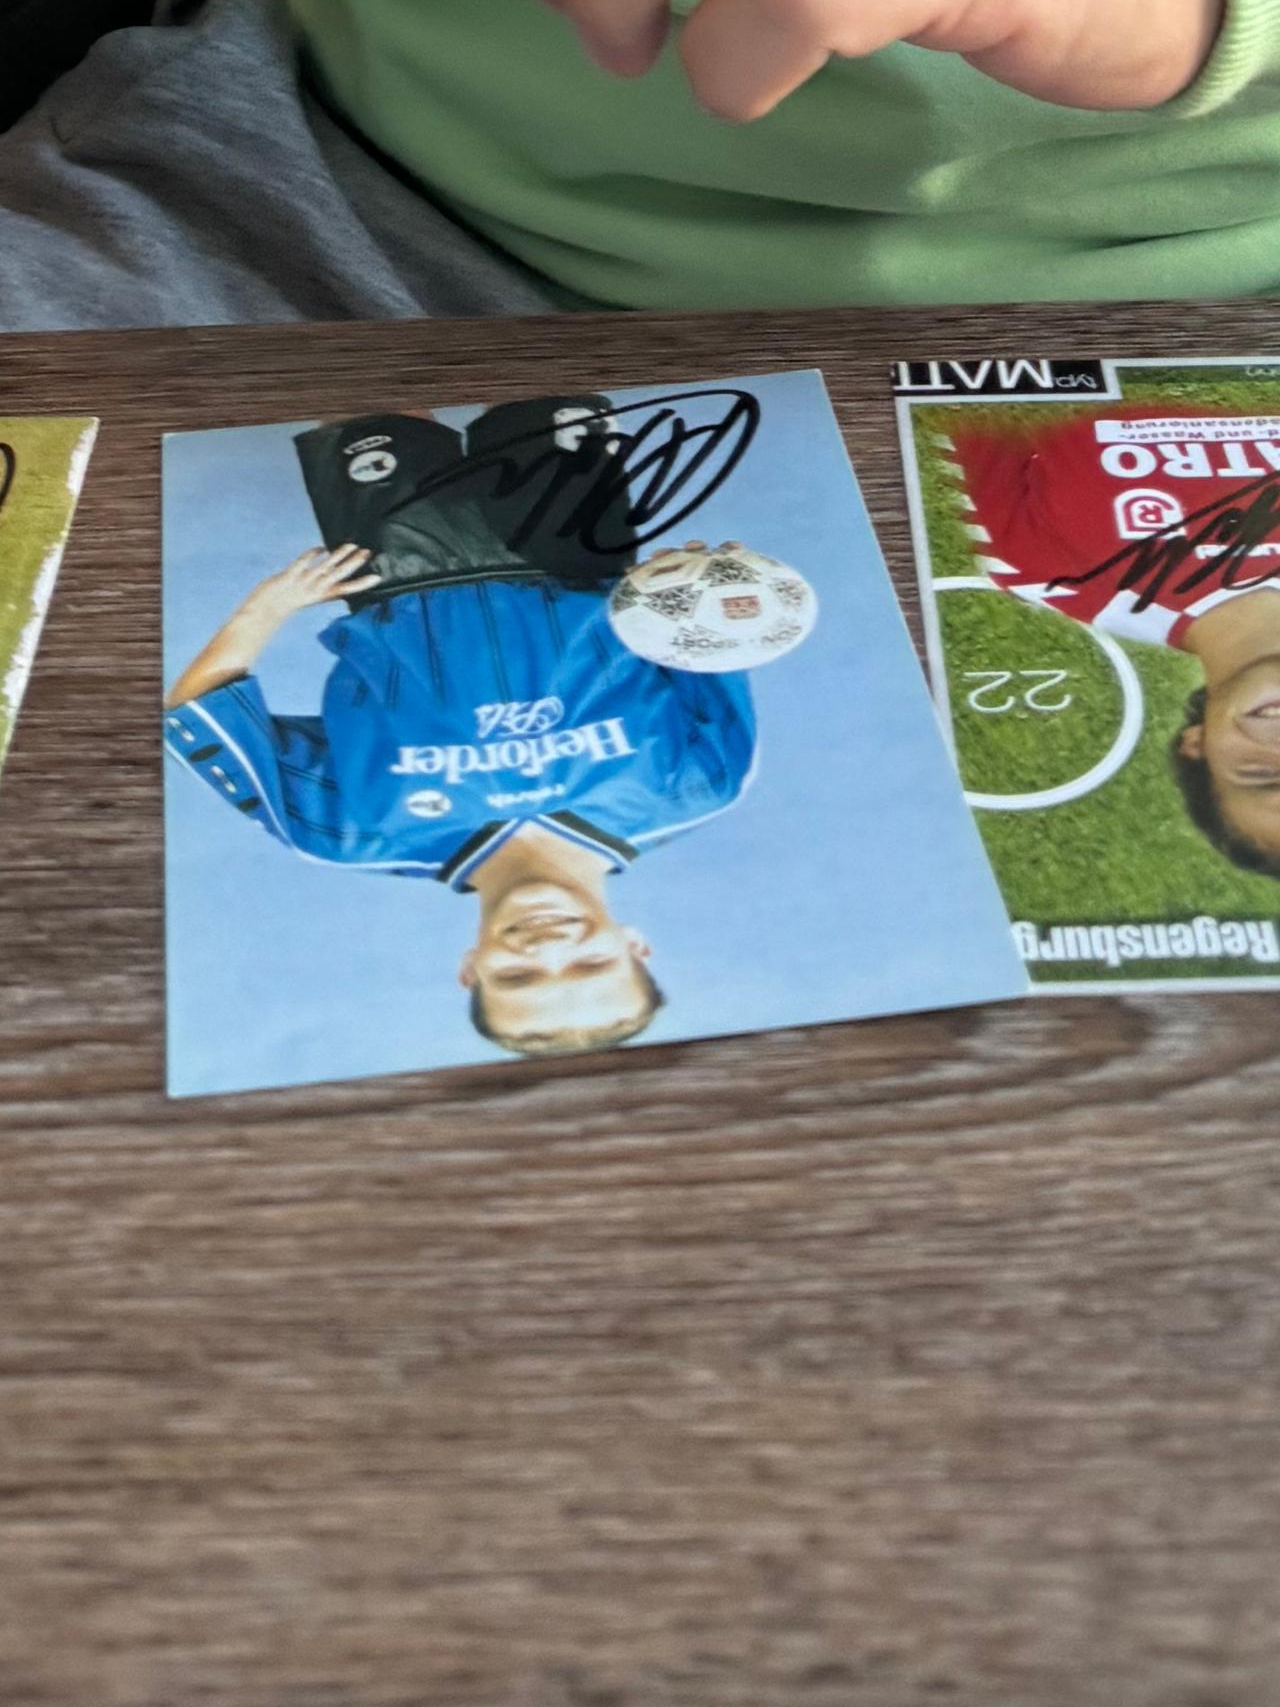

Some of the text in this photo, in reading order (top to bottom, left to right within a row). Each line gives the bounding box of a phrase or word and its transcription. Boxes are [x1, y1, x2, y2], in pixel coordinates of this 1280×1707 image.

[961, 668, 1073, 713] 22
[474, 694, 566, 739] Pils
[391, 718, 638, 783] Herforder
